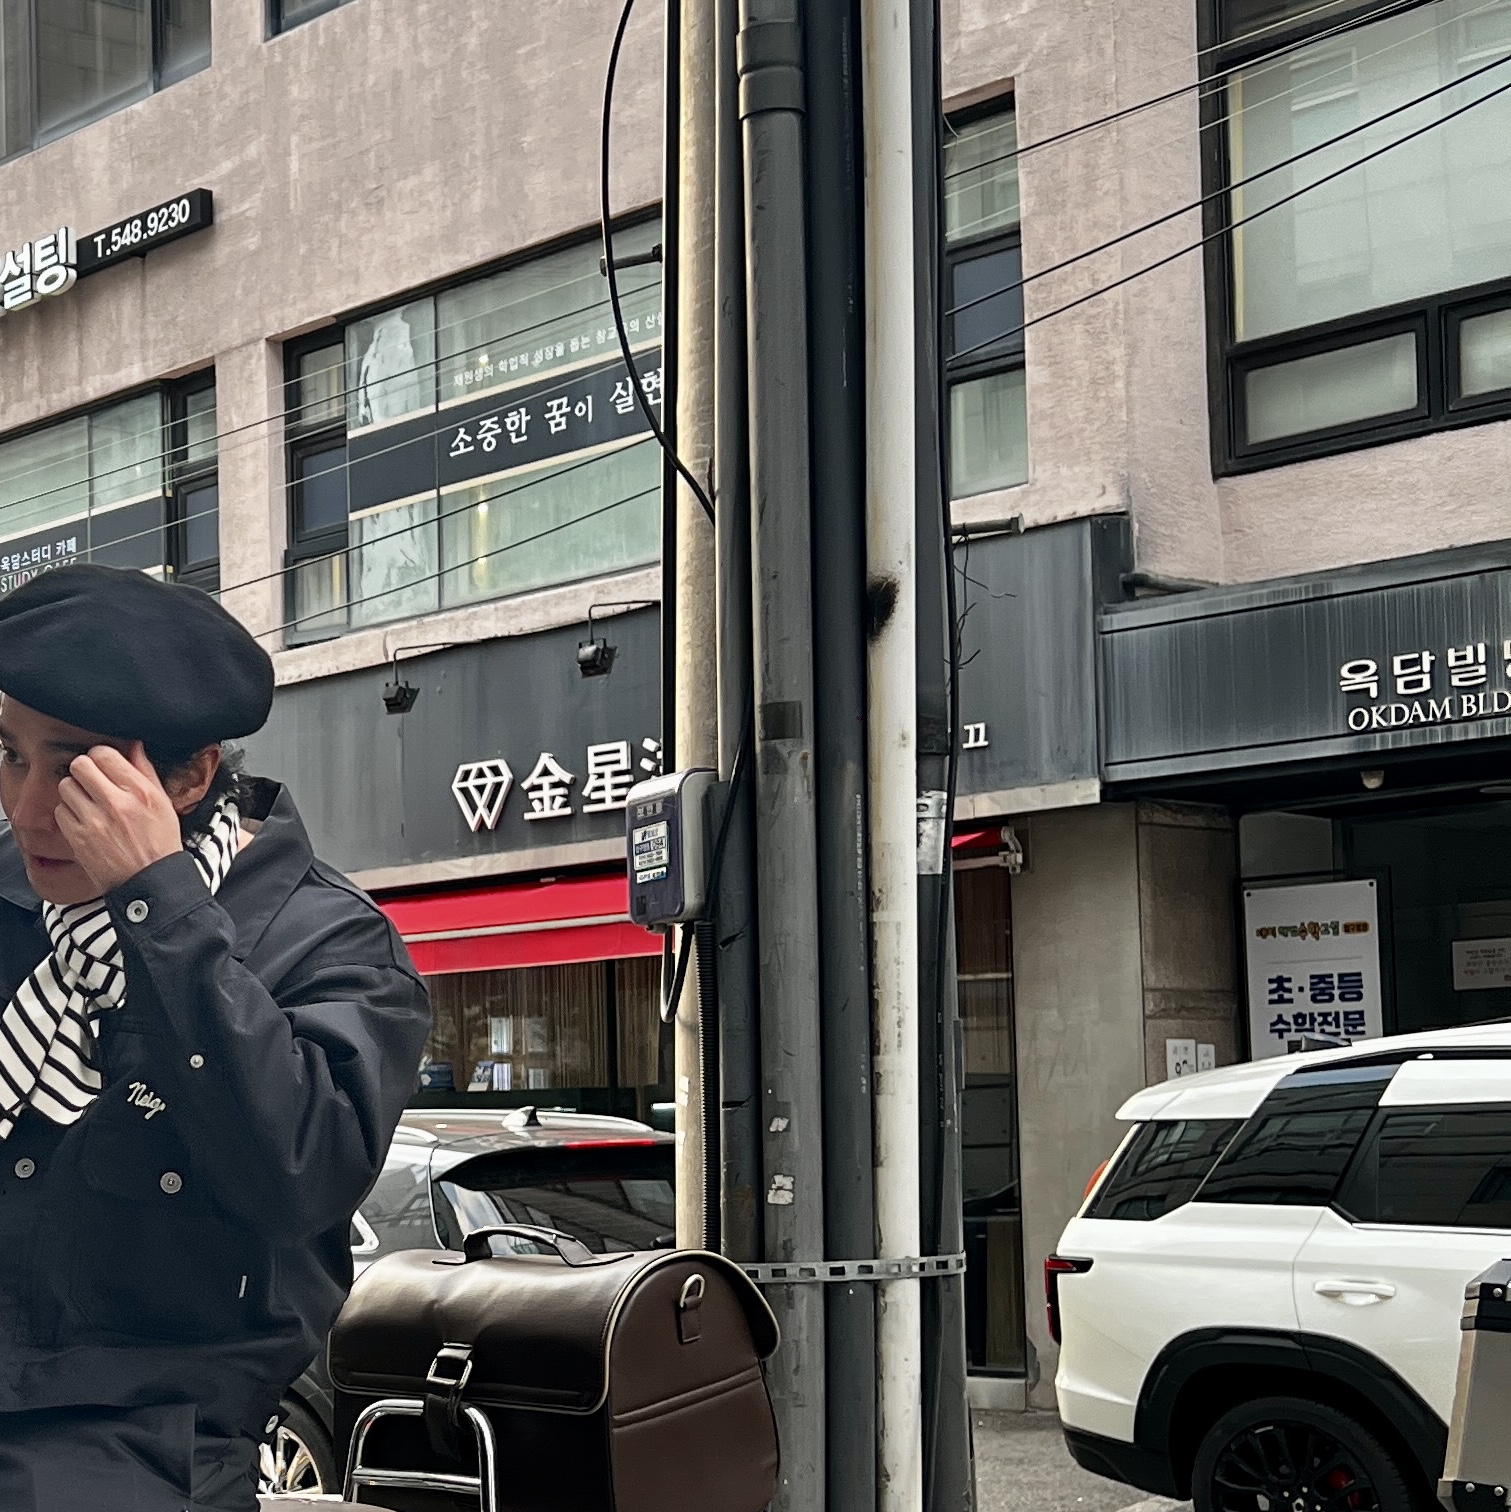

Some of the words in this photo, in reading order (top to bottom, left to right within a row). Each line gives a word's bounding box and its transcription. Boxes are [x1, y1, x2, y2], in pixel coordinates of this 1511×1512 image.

[93, 197, 192, 259] T.548.9230
[449, 407, 531, 457] 소중한
[544, 394, 593, 434] 꿈이
[0, 543, 51, 572] 옥담스터디
[1348, 696, 1453, 731] OKDAM
[1268, 972, 1363, 1005] 초·중등
[1269, 1010, 1366, 1039] 수학전문
